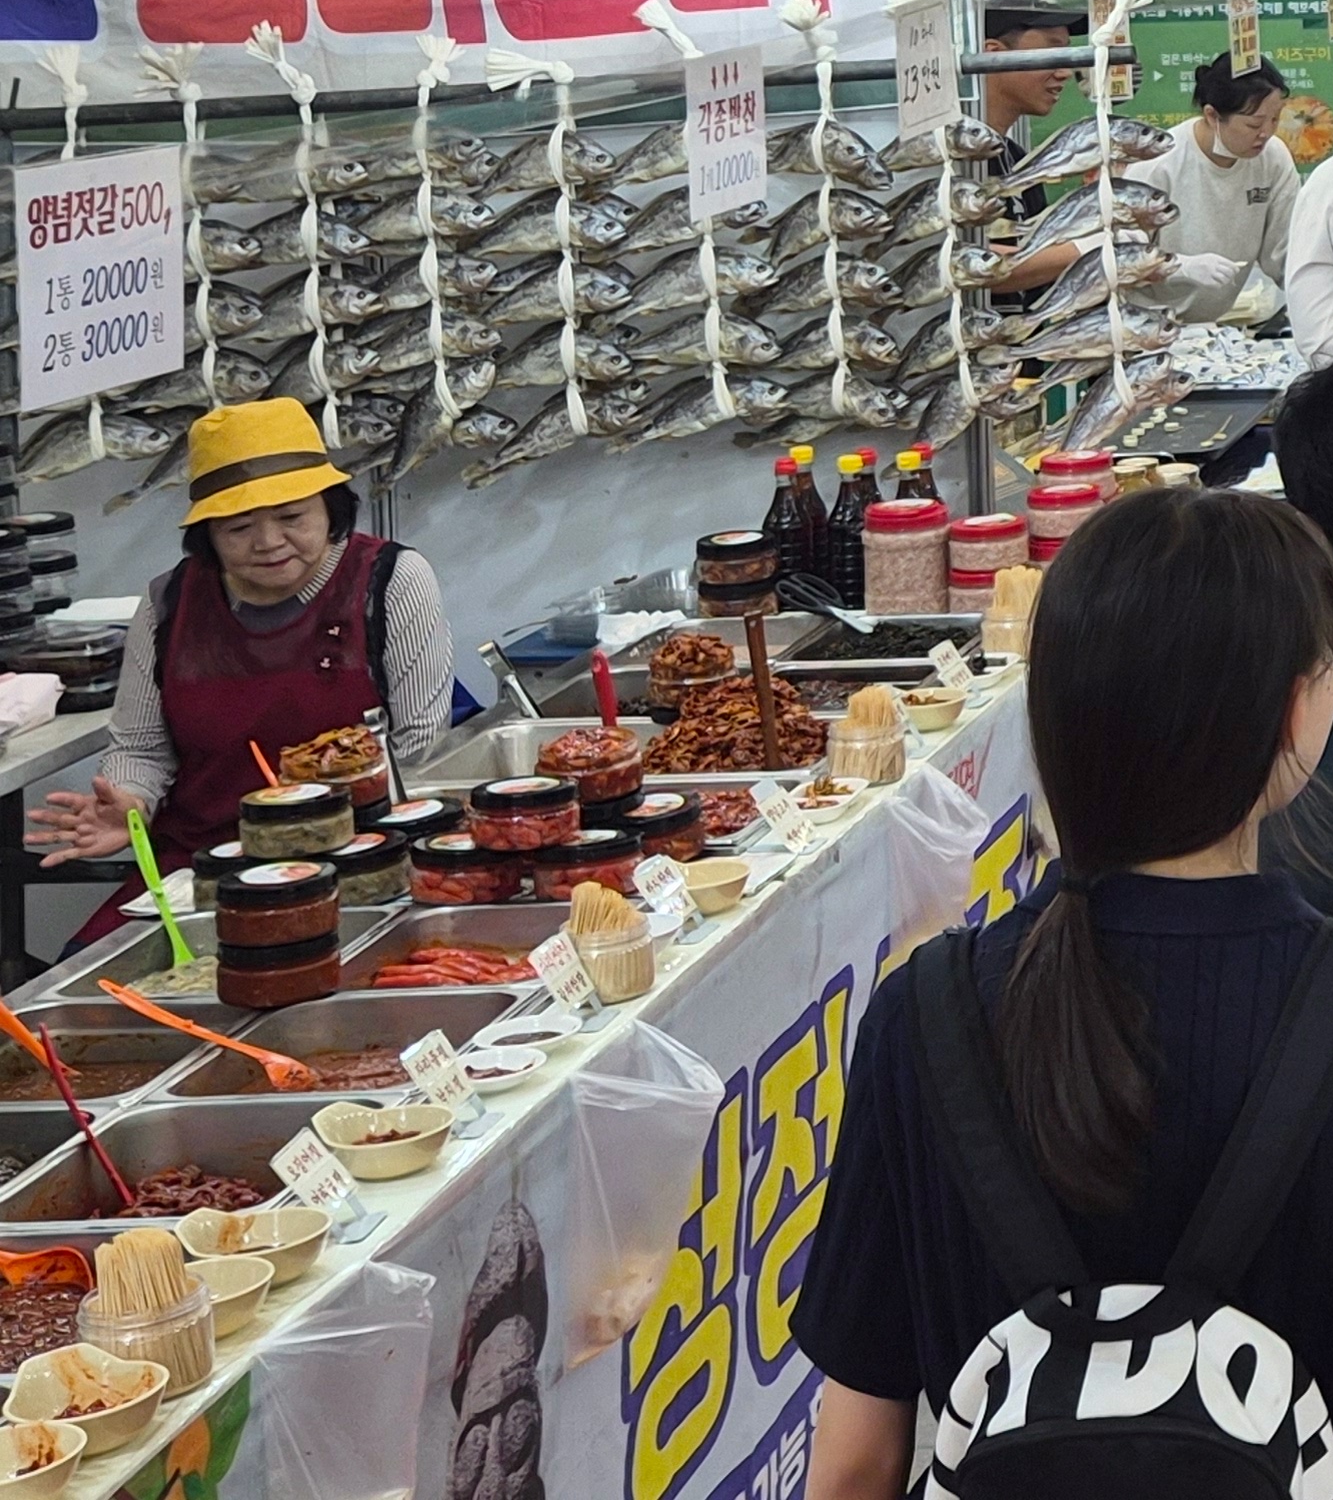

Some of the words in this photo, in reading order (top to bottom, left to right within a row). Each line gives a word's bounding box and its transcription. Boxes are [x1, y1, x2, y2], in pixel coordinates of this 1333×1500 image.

[1276, 46, 1332, 62] 치즈구이
[697, 89, 757, 145] 각종반찬
[28, 183, 119, 250] 양념젓갈
[44, 274, 75, 316] 1통
[81, 256, 165, 308] 20000원
[42, 331, 76, 373] 2통
[81, 310, 165, 362] 30000원
[287, 1141, 323, 1182] 오징어젓
